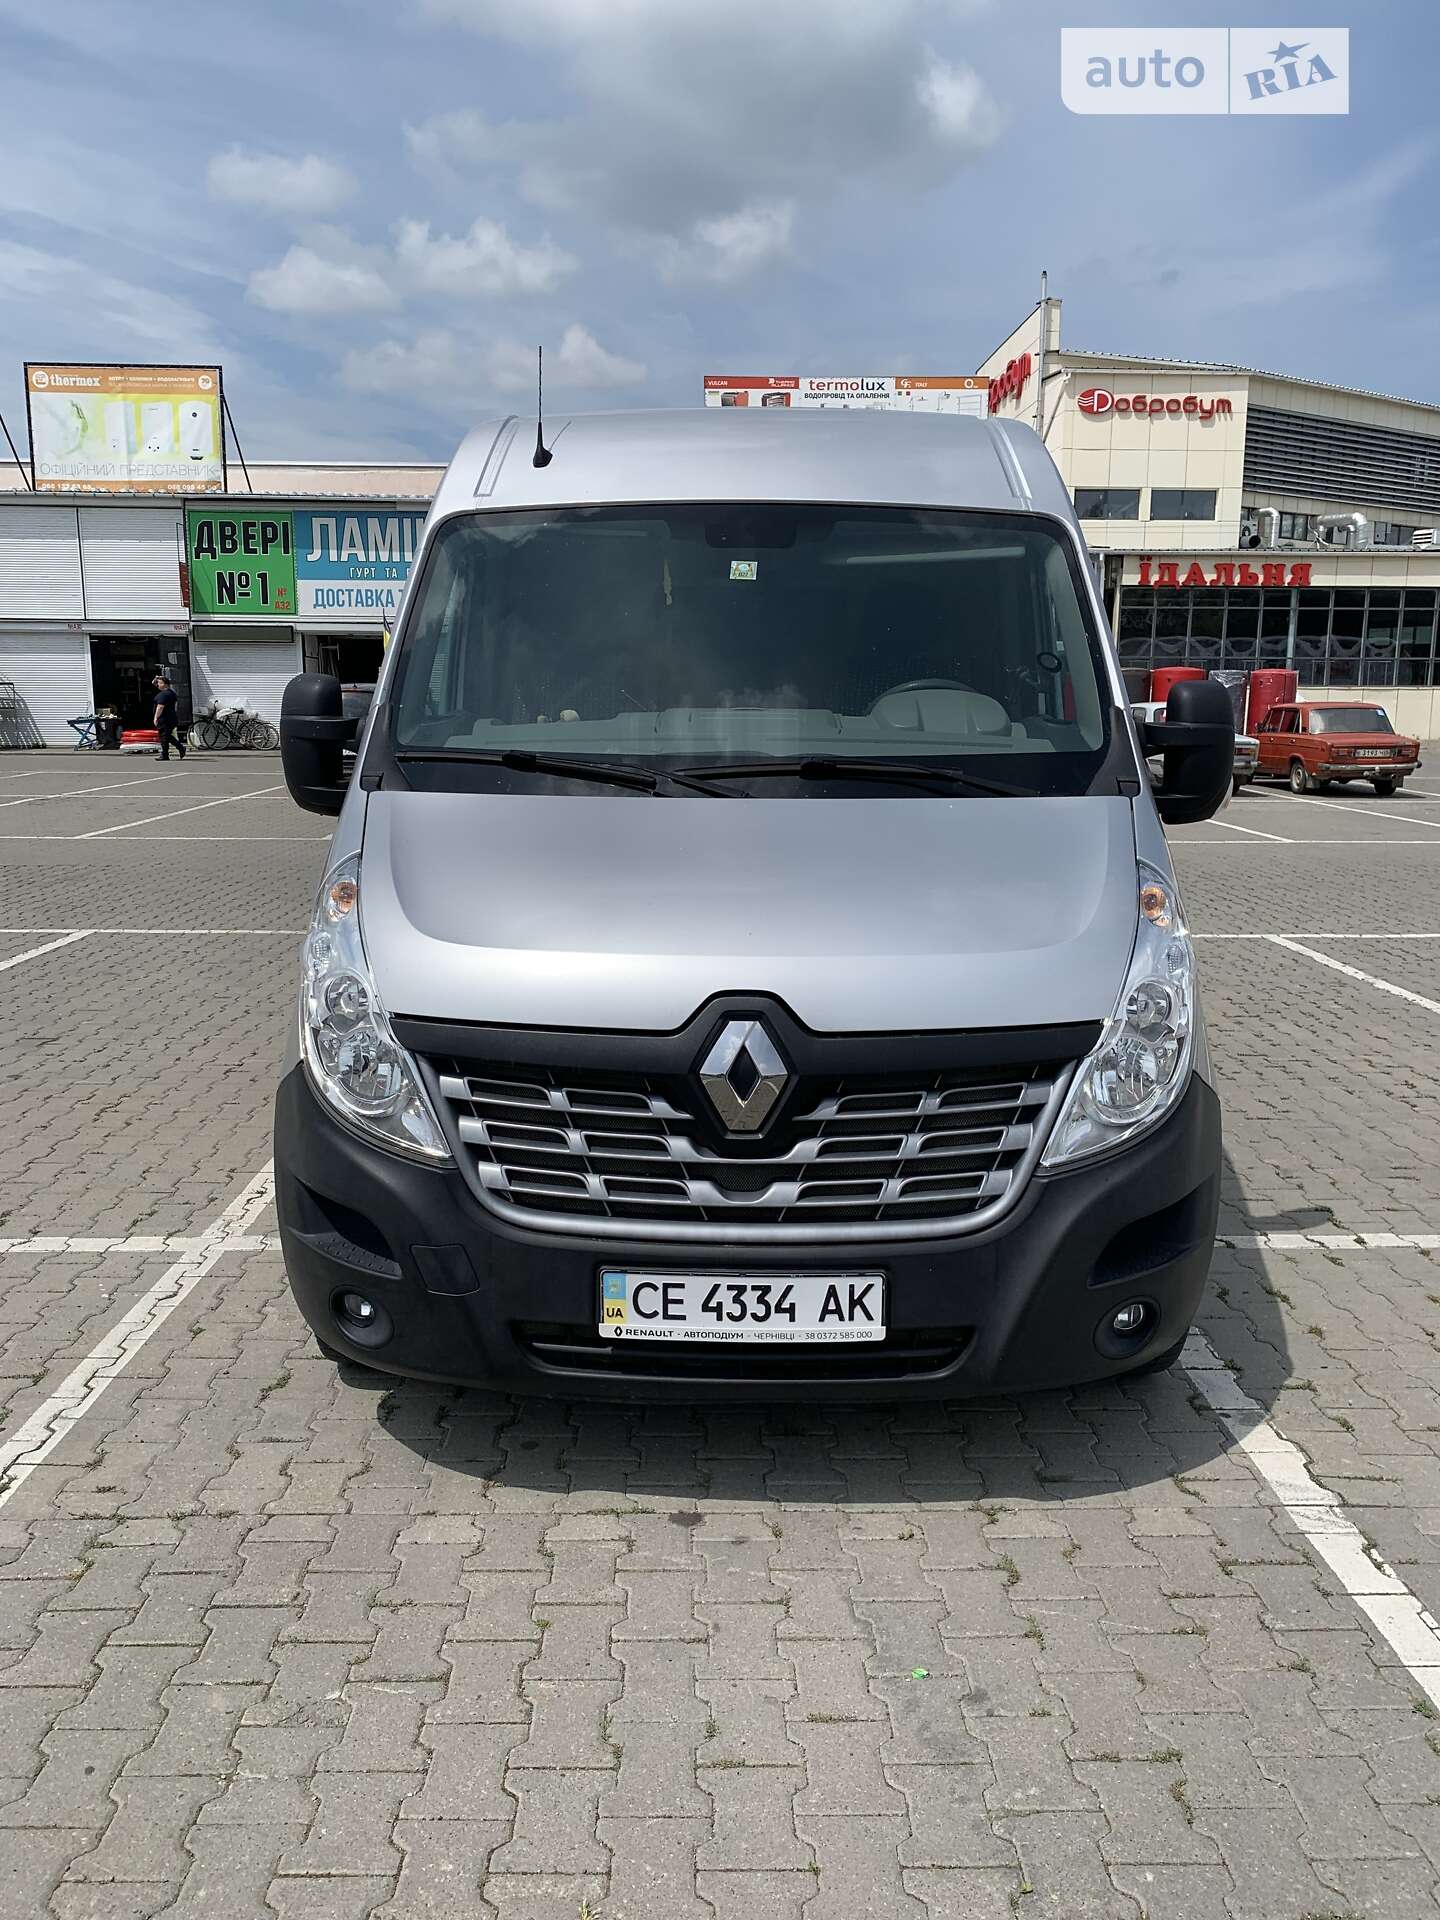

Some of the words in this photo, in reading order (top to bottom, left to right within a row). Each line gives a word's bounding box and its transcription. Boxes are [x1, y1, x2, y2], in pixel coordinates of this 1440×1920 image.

[50, 374, 100, 387] thermex
[809, 378, 885, 391] termolux
[39, 462, 115, 477] ОФІЦІЙНИЙ
[194, 519, 291, 560] ДВЕРІ
[350, 567, 376, 578] ГУРТ
[384, 567, 398, 578] ТА
[1138, 555, 1312, 590] ЇДАЛЬНЯ
[313, 588, 395, 608] ДОСТАВКА
[632, 1282, 687, 1321] CE
[701, 1283, 797, 1322] 4334
[818, 1283, 874, 1322] AK
[606, 1308, 623, 1318] UA
[625, 1329, 674, 1337] RENAULT
[684, 1331, 744, 1340] АВТОПОДІУМ
[754, 1332, 795, 1341] ЧЕРНІВЦІ
[856, 1331, 873, 1339] 000
